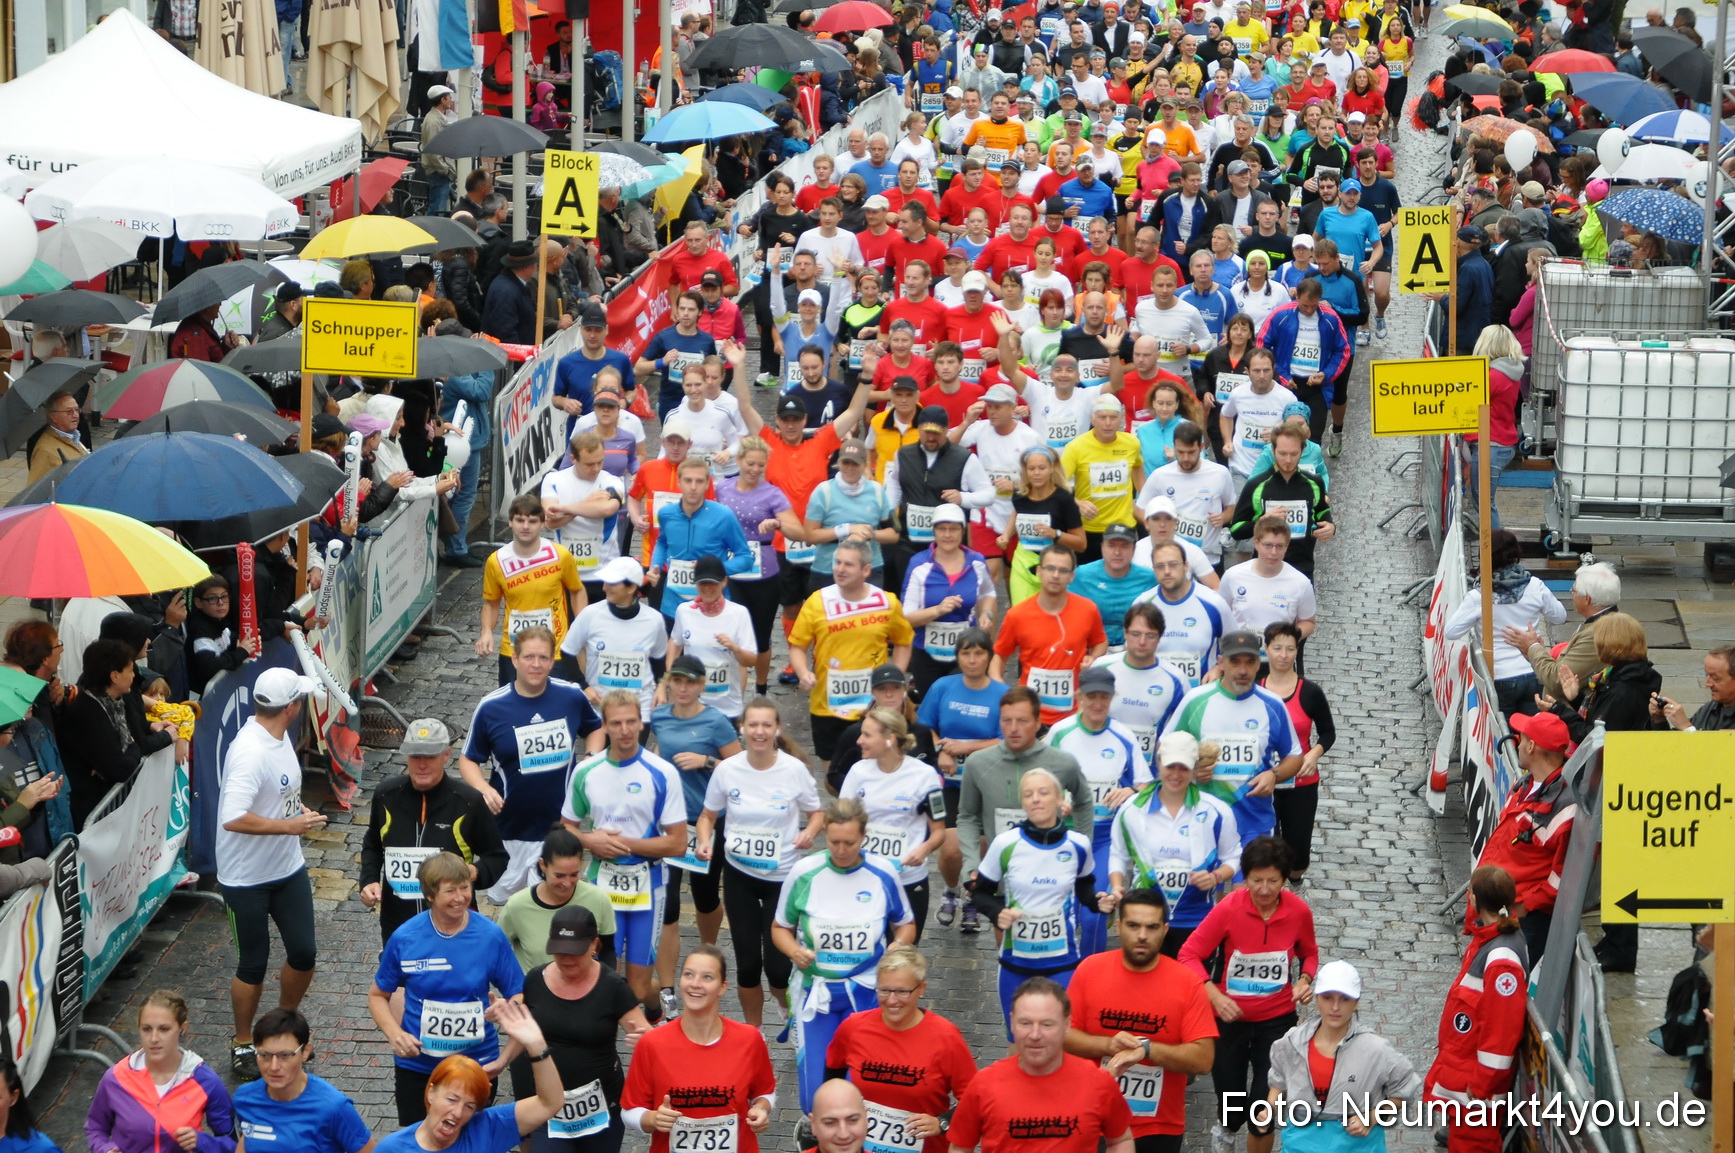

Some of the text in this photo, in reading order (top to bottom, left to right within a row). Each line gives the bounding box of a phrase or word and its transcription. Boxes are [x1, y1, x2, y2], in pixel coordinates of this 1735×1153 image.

[550, 152, 593, 171] Block
[273, 172, 289, 188] Von
[553, 176, 586, 218] A
[131, 219, 160, 232] BKK
[276, 217, 291, 230] BKK
[1404, 209, 1450, 227] Block
[1074, 221, 1090, 232] 248
[1410, 232, 1444, 275] A
[1030, 287, 1042, 298] 41
[310, 319, 409, 339] Schnupper-
[344, 341, 376, 357] lauf
[1293, 346, 1319, 360] 2452
[1378, 380, 1480, 398] Schnupper-
[1413, 400, 1446, 417] lauf
[1048, 424, 1078, 440] 2825
[1245, 427, 1263, 441] 24
[1098, 469, 1122, 484] 449
[910, 513, 933, 528] 303
[1286, 509, 1304, 524] 36
[568, 543, 593, 557] 483
[507, 564, 562, 590] MAX BÖGL
[671, 569, 696, 585] 309
[242, 593, 252, 618] BKK
[242, 621, 252, 635] di
[827, 620, 856, 633] MAX
[929, 630, 957, 646] 210
[602, 661, 641, 678] 2133
[709, 669, 727, 684] 40
[1170, 662, 1196, 677] 05
[831, 679, 870, 695] 3007
[1121, 697, 1150, 708] Stefan
[535, 726, 561, 735] Neumarkt
[523, 732, 567, 756] 2542
[529, 753, 564, 766] Alexander
[1217, 745, 1255, 762] 815
[285, 794, 301, 818] 213
[1607, 783, 1735, 818] Jugend-
[1642, 820, 1700, 848] lauf
[731, 837, 776, 857] 2199
[862, 836, 902, 857] 2200
[1159, 845, 1181, 856] Anja
[390, 859, 420, 879] 297
[400, 882, 421, 892] Huber
[608, 874, 641, 892] 431
[1031, 876, 1058, 886] Anke
[1156, 871, 1188, 888] 280
[610, 894, 637, 905] Willem
[1016, 918, 1062, 940] 2795
[819, 931, 868, 951] 2812
[1233, 963, 1283, 981] 2139
[445, 1006, 473, 1015] Neumarkt
[427, 1015, 478, 1038] 2624
[1117, 1074, 1157, 1099] 070
[865, 1106, 909, 1121] ARTL Neuma
[561, 1117, 596, 1133] Gabriele
[695, 1121, 726, 1129] Neumarkt
[675, 1128, 731, 1151] 2732
